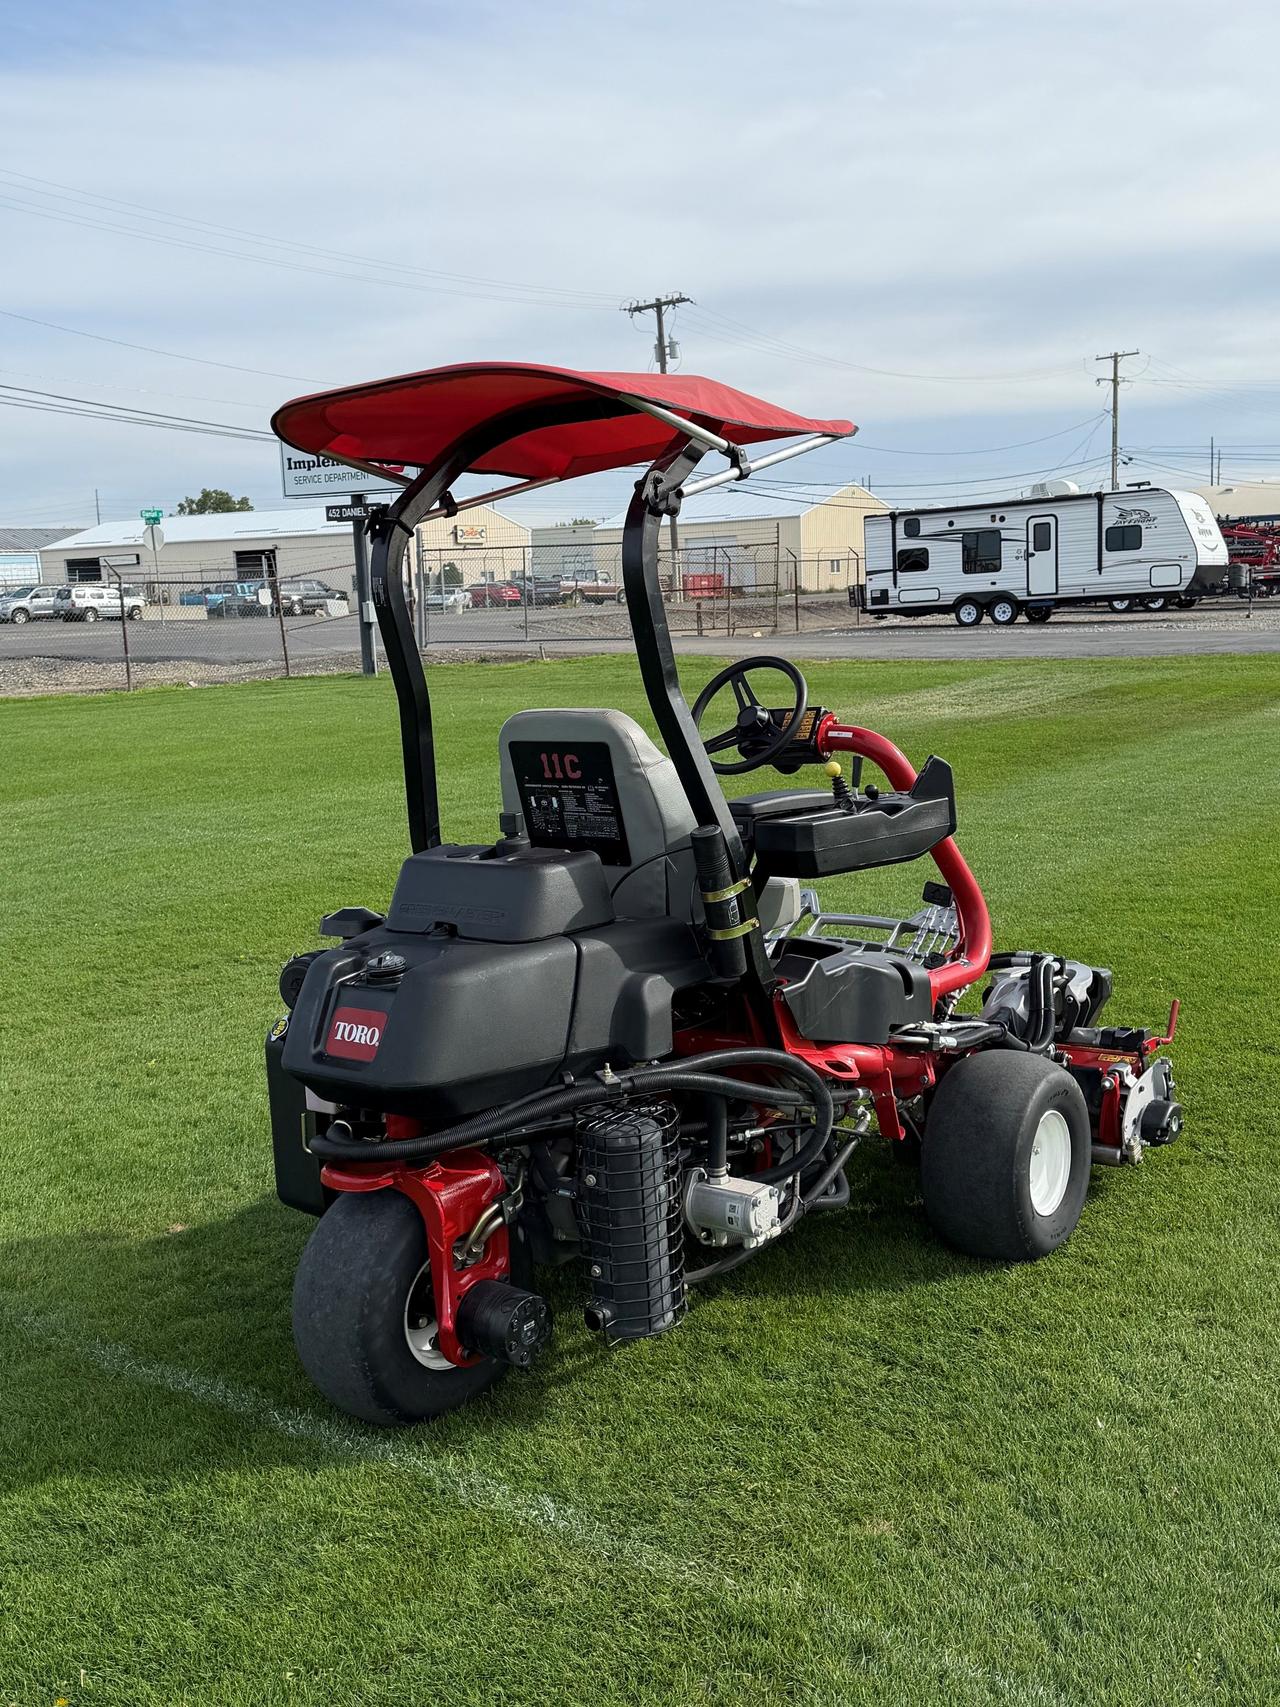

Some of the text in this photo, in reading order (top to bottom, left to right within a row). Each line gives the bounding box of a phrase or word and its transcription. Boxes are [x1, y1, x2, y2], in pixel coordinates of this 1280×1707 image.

[293, 471, 369, 485] SERVICE DEPARTMENT
[328, 508, 340, 518] 452
[341, 507, 367, 517] DANIEL
[540, 753, 582, 779] 11C
[334, 1021, 379, 1046] TORO
